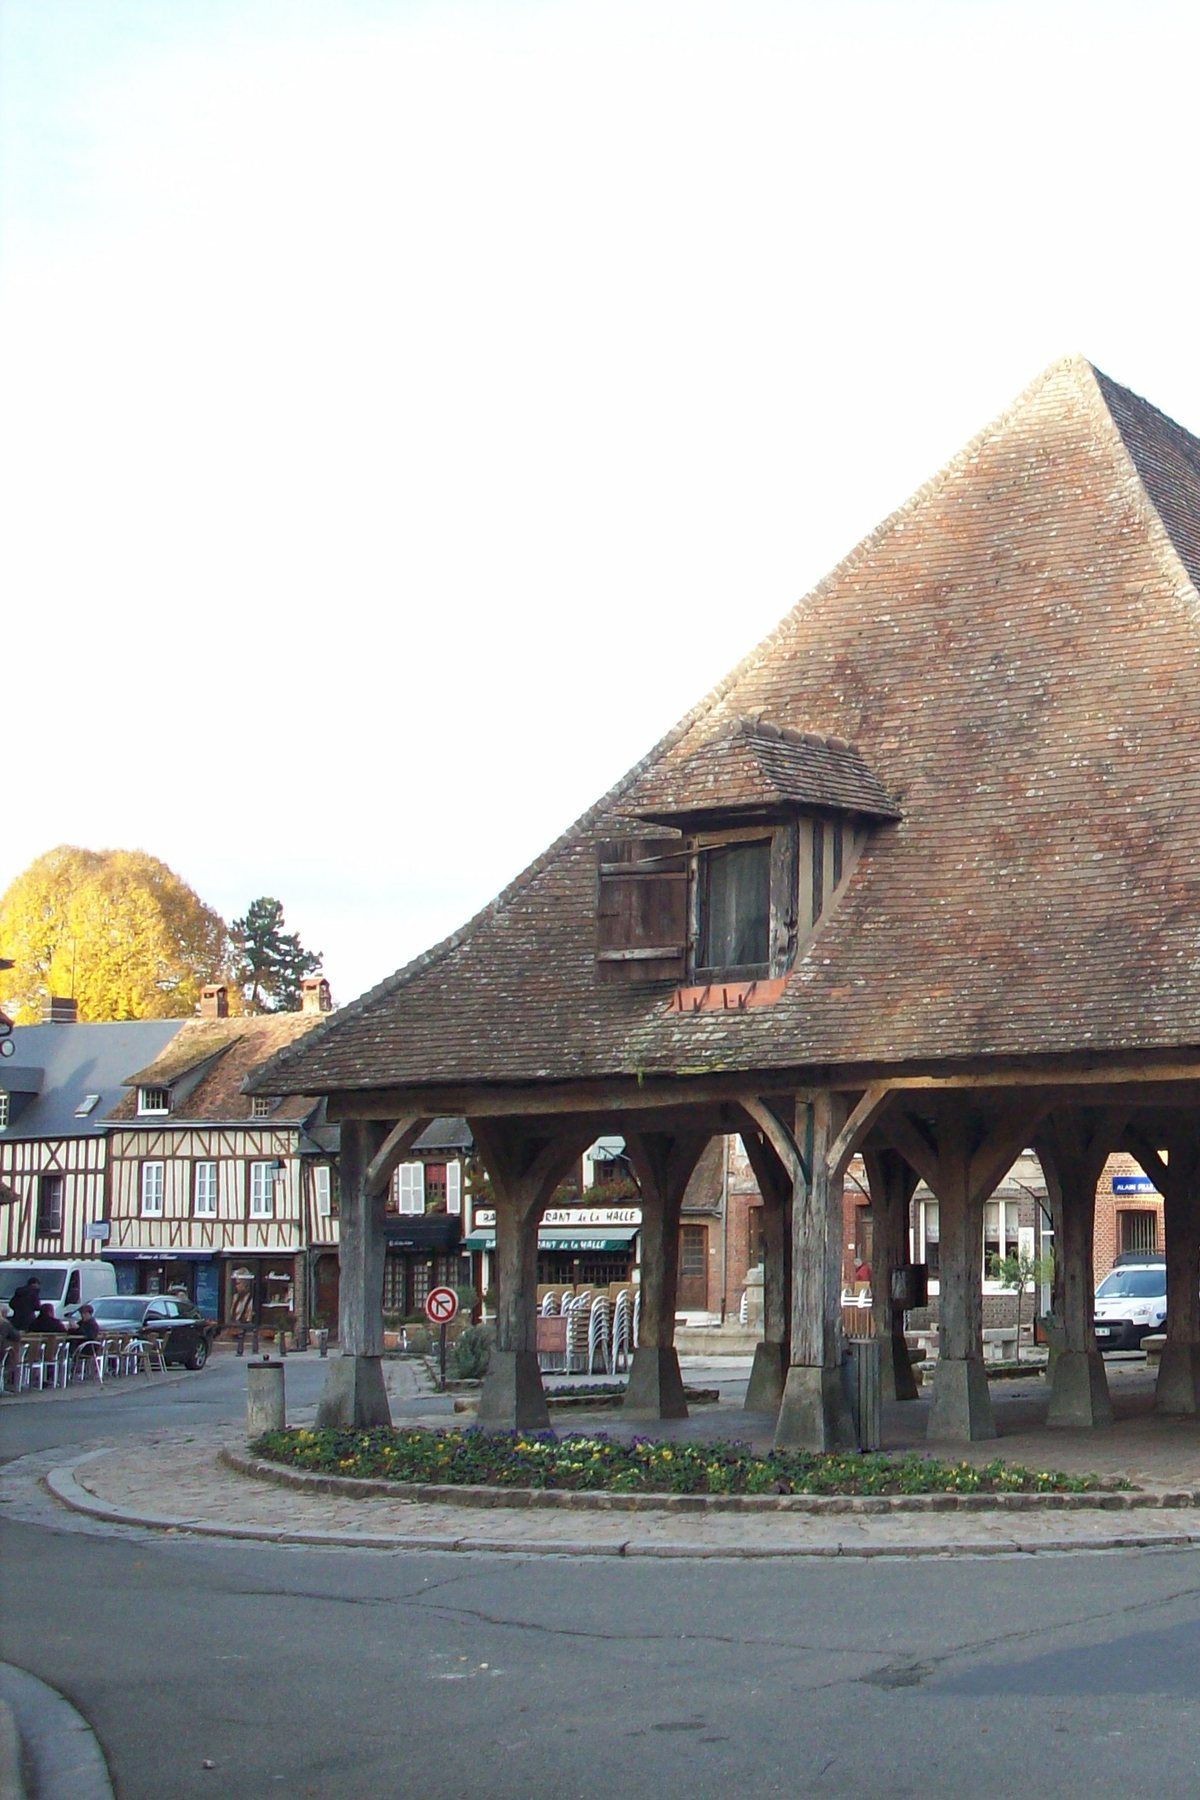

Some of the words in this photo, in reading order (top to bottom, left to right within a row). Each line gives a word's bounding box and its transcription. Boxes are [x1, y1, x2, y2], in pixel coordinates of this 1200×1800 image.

[483, 1212, 496, 1221] BA
[545, 1212, 571, 1222] RANT
[606, 1211, 635, 1222] HALLE
[486, 1239, 496, 1248] BA
[537, 1240, 556, 1249] ANT
[580, 1240, 606, 1250] HALLE
